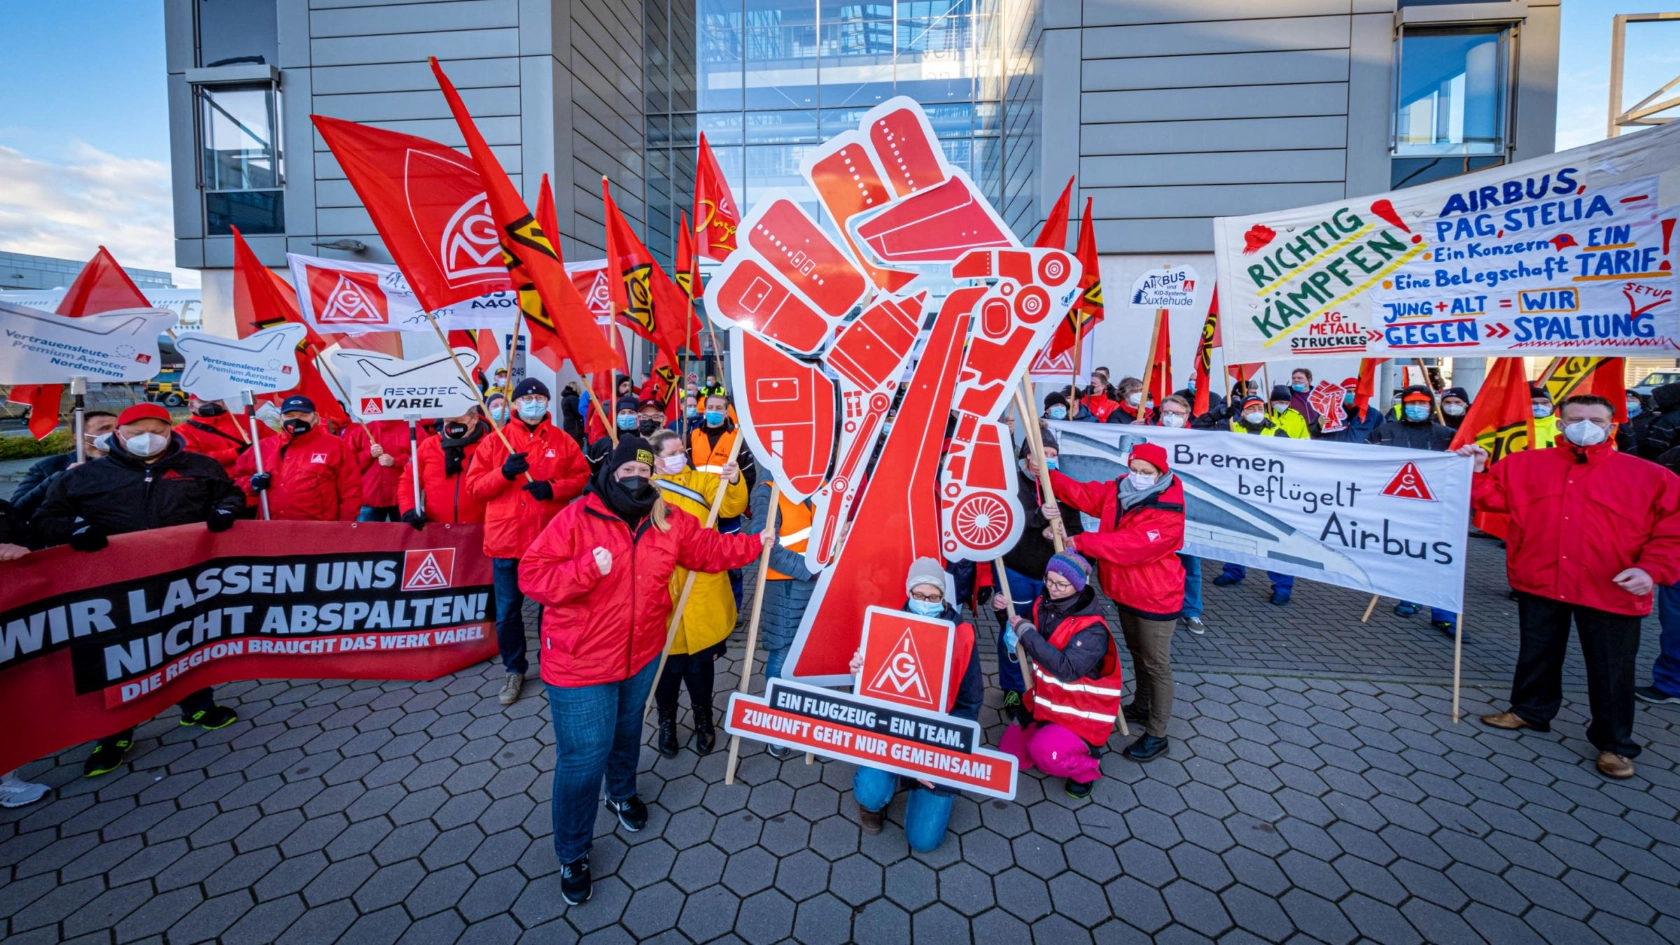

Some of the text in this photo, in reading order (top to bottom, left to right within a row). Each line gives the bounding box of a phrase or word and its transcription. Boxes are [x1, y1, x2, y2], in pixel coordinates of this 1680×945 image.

[1439, 168, 1586, 218] AIRBUS,
[1248, 207, 1364, 288] RICHTIG
[1434, 224, 1631, 262] Ein Konzern EIN
[1143, 271, 1186, 290] AIRBUS
[1395, 274, 1430, 290] Eine
[1624, 282, 1673, 298] SETUP
[1132, 288, 1192, 306] Buxtehude
[1522, 290, 1575, 310] WIR
[6, 329, 110, 358] Vertrauensleute
[1291, 336, 1367, 348] STRUCKIES
[1385, 314, 1656, 346] GEGEN SPALTUNG
[12, 340, 75, 360] Premium
[76, 354, 128, 371] Aerotec
[50, 357, 124, 378] Nordenham
[202, 356, 264, 372] Vertrauensleute
[207, 364, 278, 382] Premium Aerotec
[230, 376, 276, 388] Nordenham
[384, 386, 458, 396] AEROTEC
[384, 398, 443, 409] VAREL
[1174, 444, 1285, 474] Bremen
[1238, 474, 1362, 514] beflügelt
[1320, 512, 1454, 564] Airbus
[0, 559, 398, 663] WIR LASSEN UNS
[104, 592, 489, 681] NICHT ABSPALTEN!
[121, 626, 485, 703] DIE REGION BRAUCHT DAS WERK VAREL
[776, 691, 801, 711] EIN
[802, 697, 876, 728] FLUGZEUG
[890, 716, 916, 736] EIN
[919, 722, 966, 750] TEAM.
[742, 708, 992, 782] ZUKUNFT GEHT NUR GEMEINSAM!
